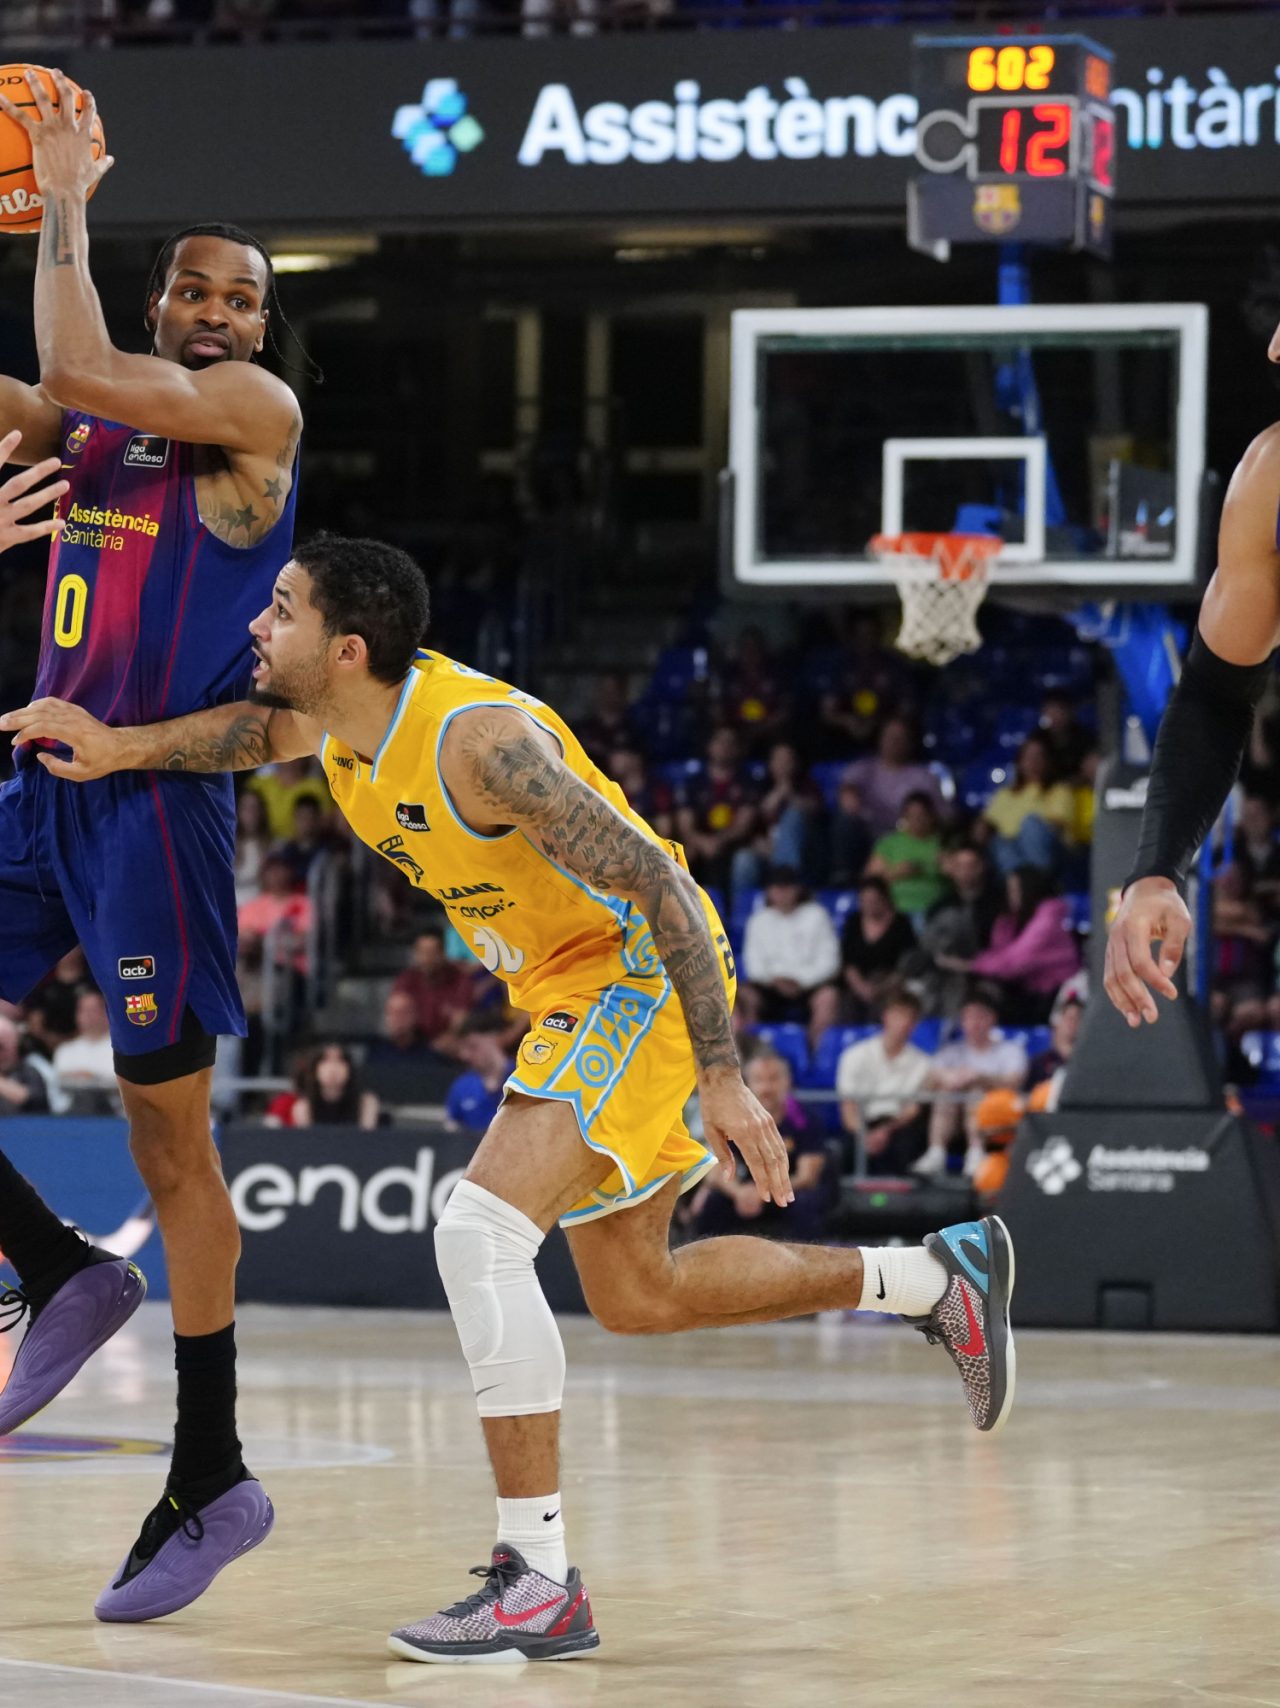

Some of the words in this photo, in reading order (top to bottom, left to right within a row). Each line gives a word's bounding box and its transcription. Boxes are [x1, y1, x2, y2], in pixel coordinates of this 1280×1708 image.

[999, 103, 1071, 176] 12
[128, 453, 163, 463] endesa
[130, 444, 146, 453] liga
[67, 502, 160, 537] Assistència
[61, 523, 124, 551] Sanitària
[54, 573, 88, 648] 0
[122, 965, 147, 976] acb
[545, 1018, 567, 1029] acb
